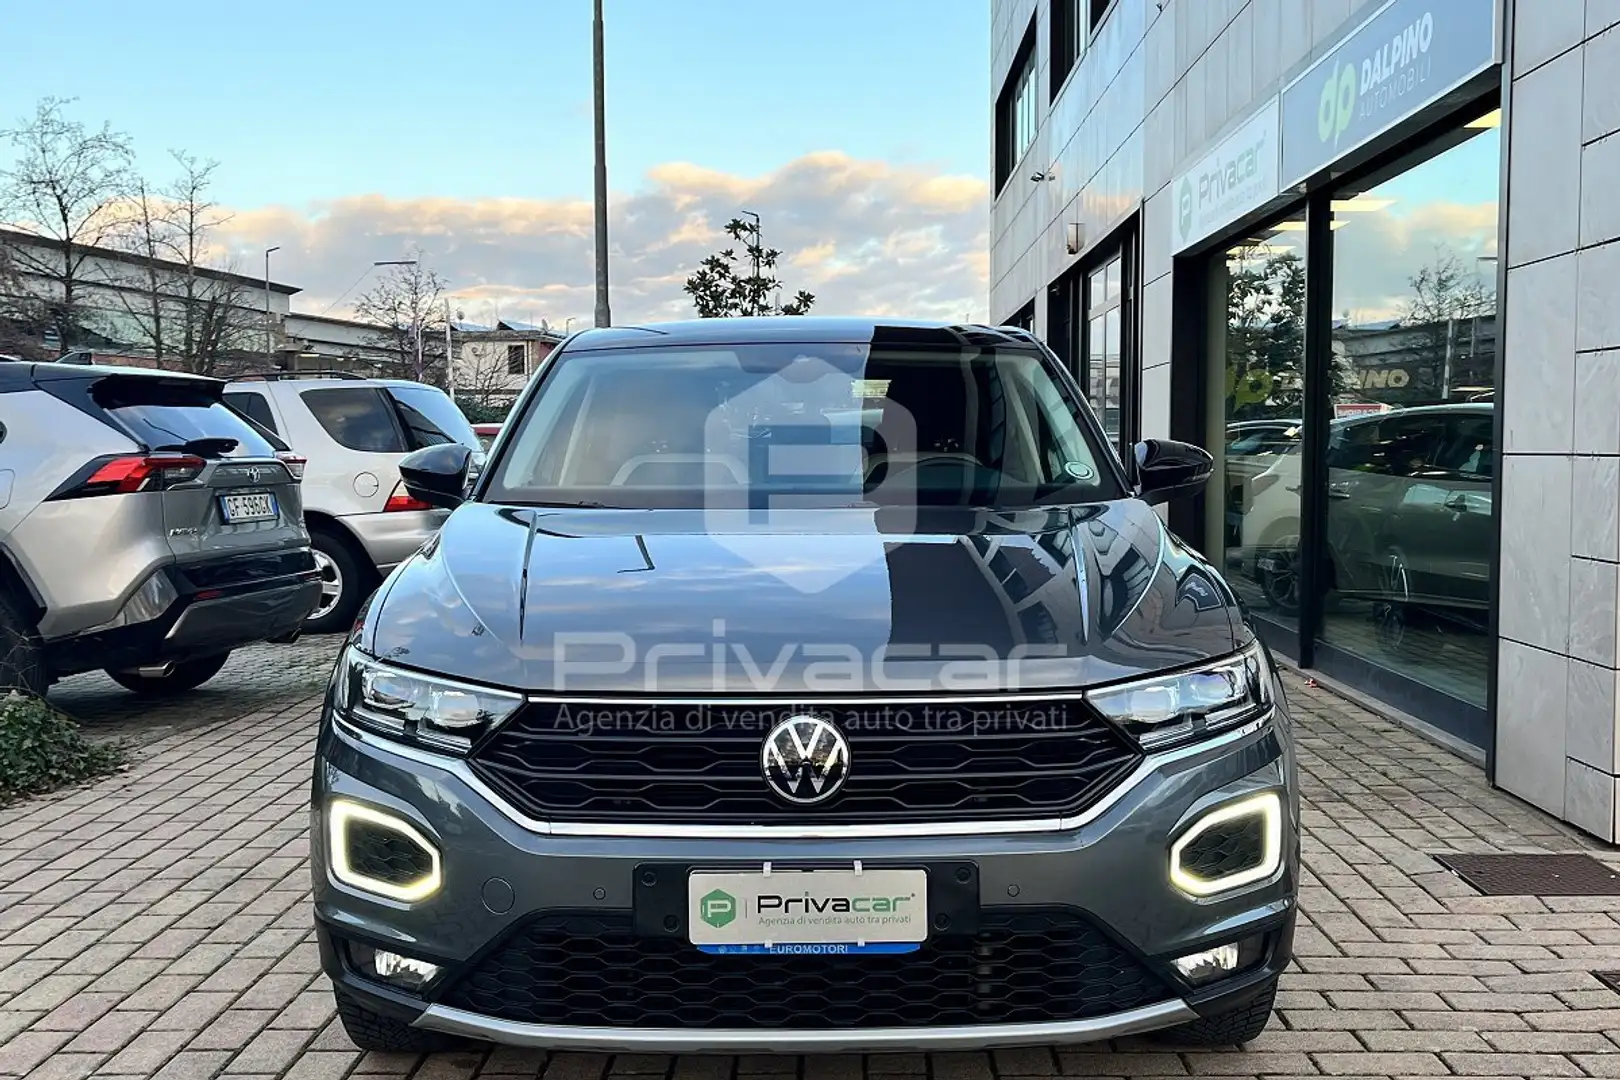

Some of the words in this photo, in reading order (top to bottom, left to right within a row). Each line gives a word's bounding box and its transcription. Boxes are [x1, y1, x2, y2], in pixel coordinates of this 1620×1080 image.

[1360, 12, 1433, 95] DALPINO
[1360, 55, 1431, 118] AUTOMOBILI
[1198, 138, 1265, 210] Privacar
[757, 891, 911, 913] Privacar
[758, 917, 795, 927] Agenzia
[797, 916, 806, 925] di
[808, 916, 842, 925] vendita
[844, 916, 866, 925] auto
[868, 916, 880, 924] tra
[881, 915, 911, 925] privati
[770, 945, 848, 954] EUROMOTORI
